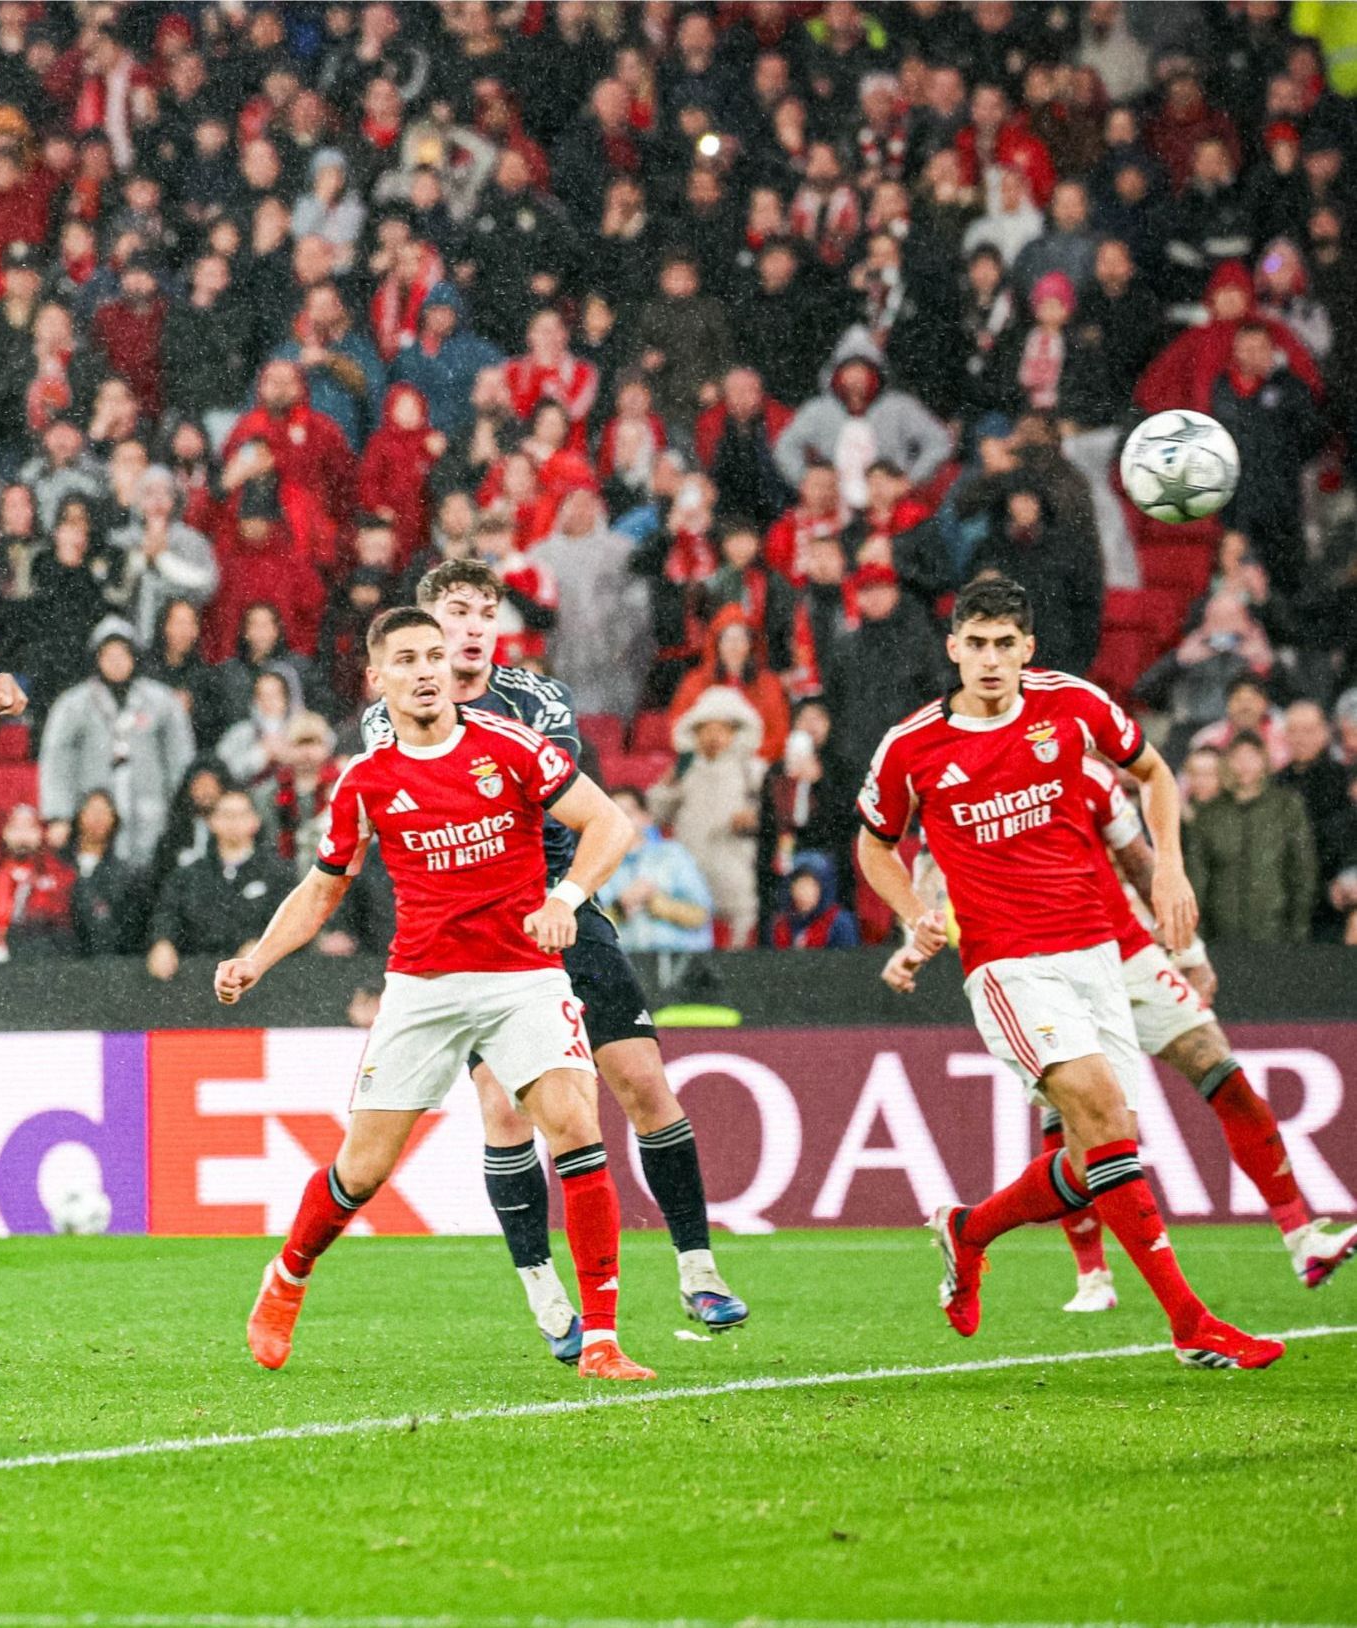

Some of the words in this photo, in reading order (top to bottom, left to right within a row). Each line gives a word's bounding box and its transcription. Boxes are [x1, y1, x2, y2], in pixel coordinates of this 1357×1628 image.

[950, 778, 1064, 827] Emirates
[401, 811, 516, 852] Emirates
[975, 821, 1000, 845] FLY
[1003, 804, 1052, 839] BETTER
[426, 850, 451, 872] FLY
[455, 835, 506, 867] BETTER
[561, 1000, 580, 1037] 9
[627, 1049, 1357, 1235] QATAR
